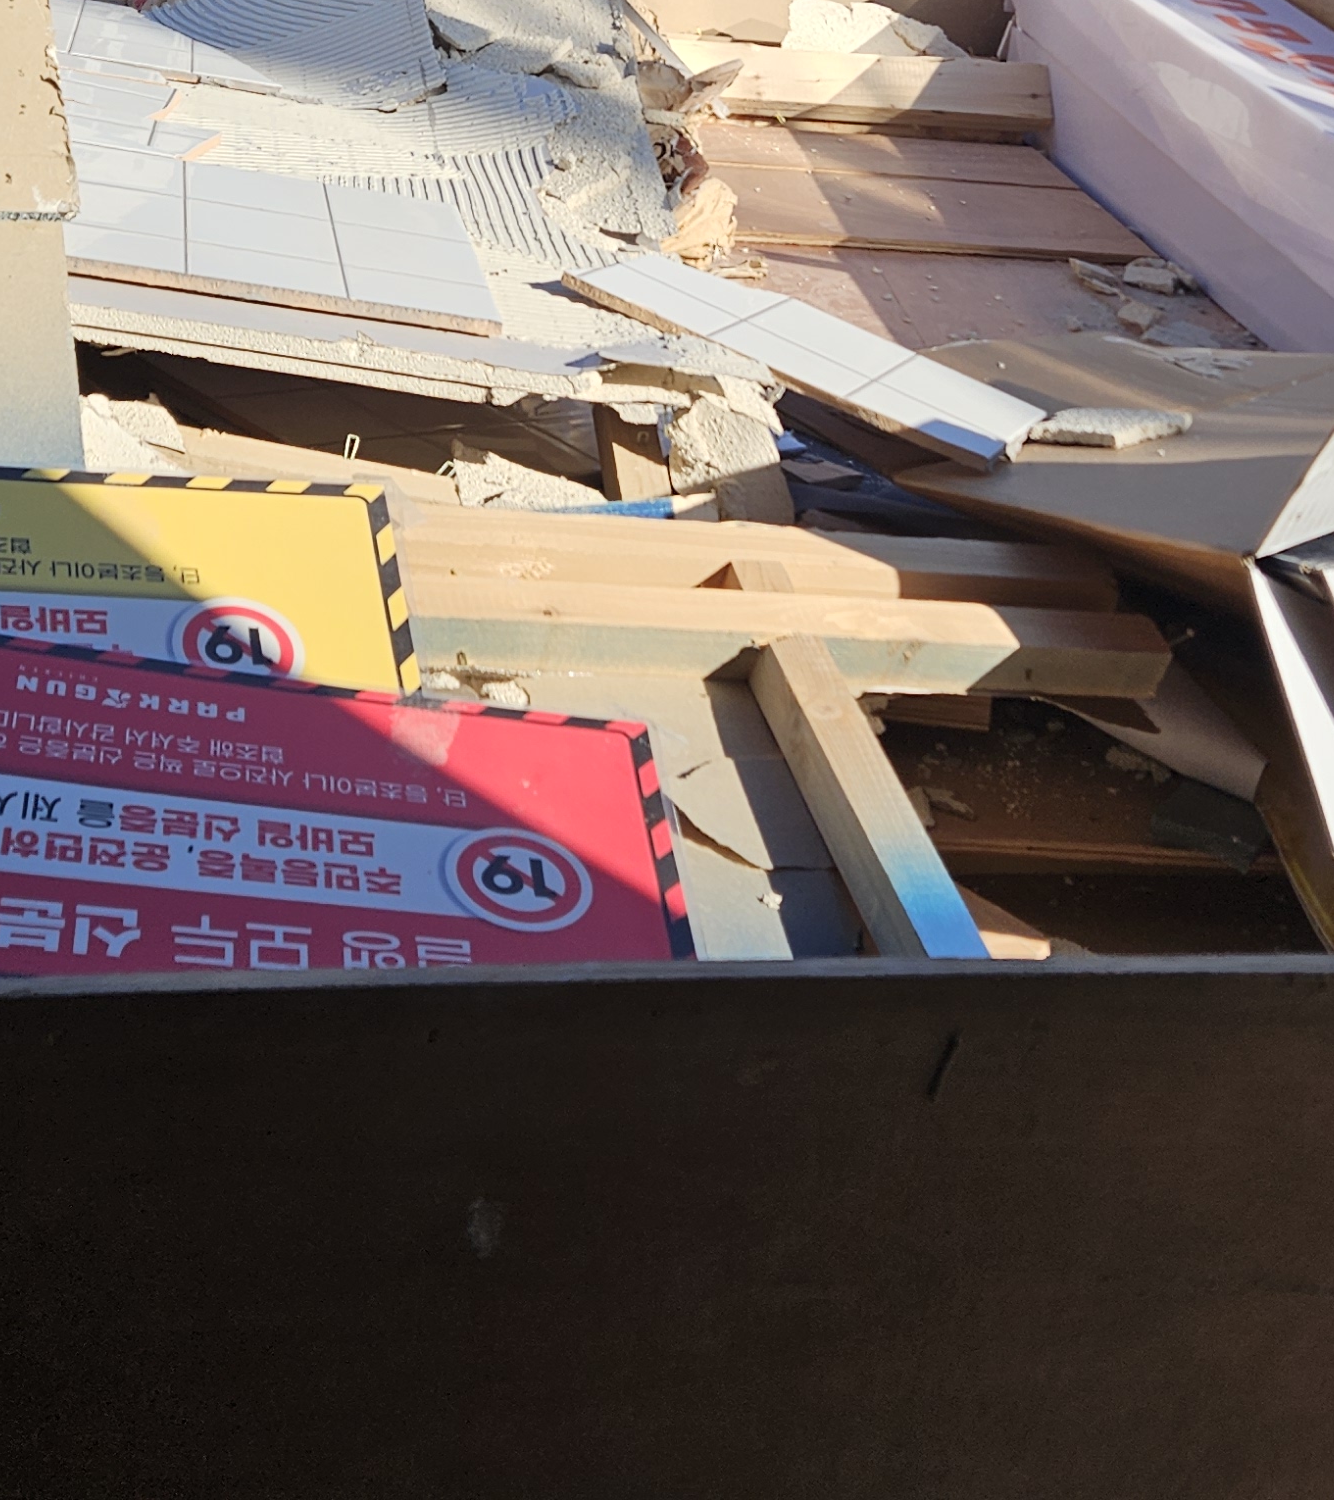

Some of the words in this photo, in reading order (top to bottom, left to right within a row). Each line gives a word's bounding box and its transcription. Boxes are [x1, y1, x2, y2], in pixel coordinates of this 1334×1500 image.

[49, 560, 165, 583] 등초본이나
[172, 564, 200, 584] 단,
[204, 625, 269, 665] 19
[16, 675, 96, 702] GUN
[139, 692, 245, 723] PARK
[18, 735, 123, 767] 신분증은
[124, 727, 201, 755] 주셔서
[209, 738, 284, 764] 협조해
[132, 752, 182, 775] 찍은
[192, 758, 294, 787] 사진으로
[303, 771, 428, 804] 등초본이나
[436, 788, 467, 808] 단,
[76, 798, 241, 843] 신분증을
[256, 819, 375, 858] 모바일
[186, 845, 402, 897] 주민등록증,
[480, 855, 560, 899] 19
[170, 914, 312, 970] 모두
